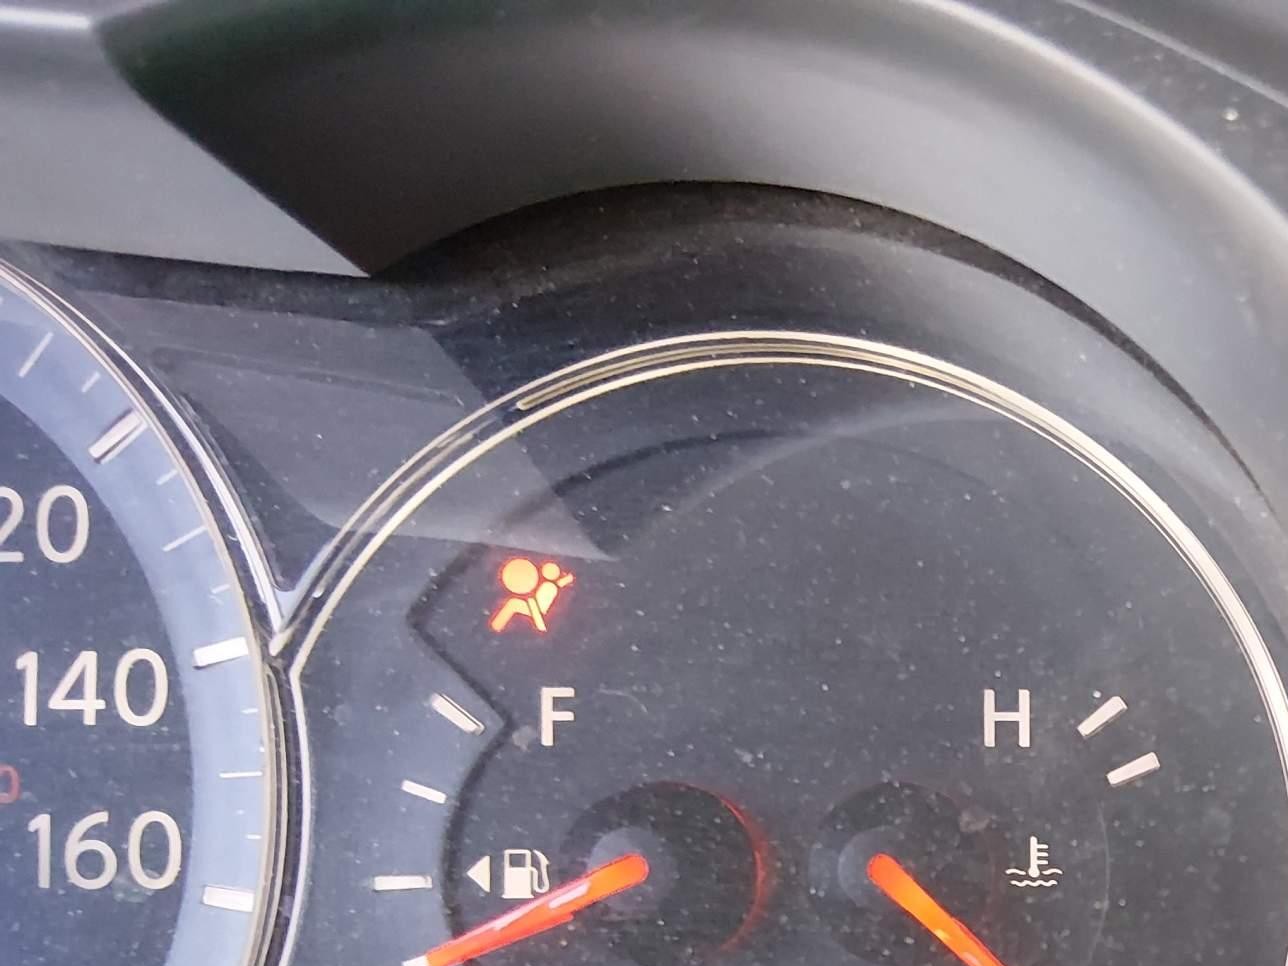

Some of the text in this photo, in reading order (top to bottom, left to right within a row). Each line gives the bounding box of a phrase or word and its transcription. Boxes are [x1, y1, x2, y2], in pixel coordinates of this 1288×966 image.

[15, 648, 169, 727] 140
[538, 685, 576, 747] F
[983, 688, 1031, 748] H
[27, 810, 182, 890] 160
